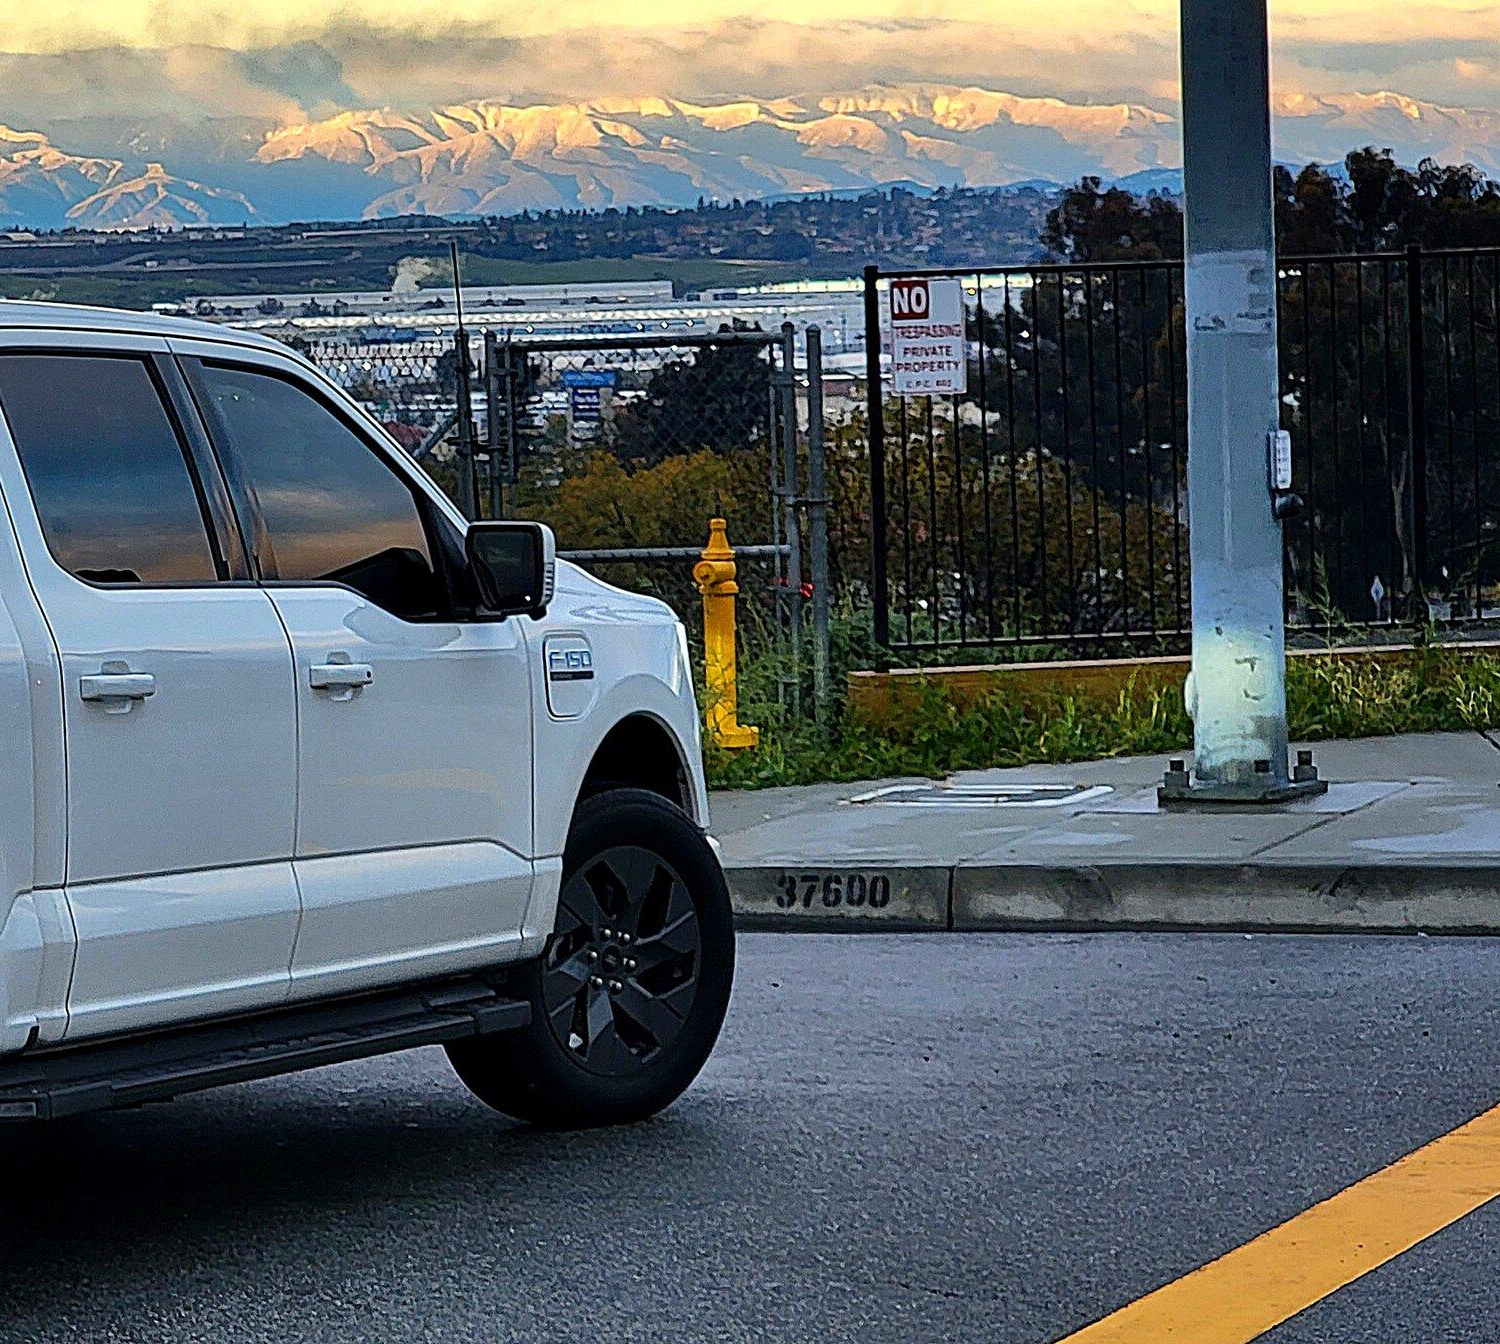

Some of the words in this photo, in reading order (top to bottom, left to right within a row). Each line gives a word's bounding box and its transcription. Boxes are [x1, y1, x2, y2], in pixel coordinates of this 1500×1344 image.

[893, 286, 927, 314] NO
[903, 346, 953, 356] PRIVATE
[896, 361, 960, 372] PROPERTY
[549, 650, 592, 669] F-150
[775, 874, 890, 908] 37600
